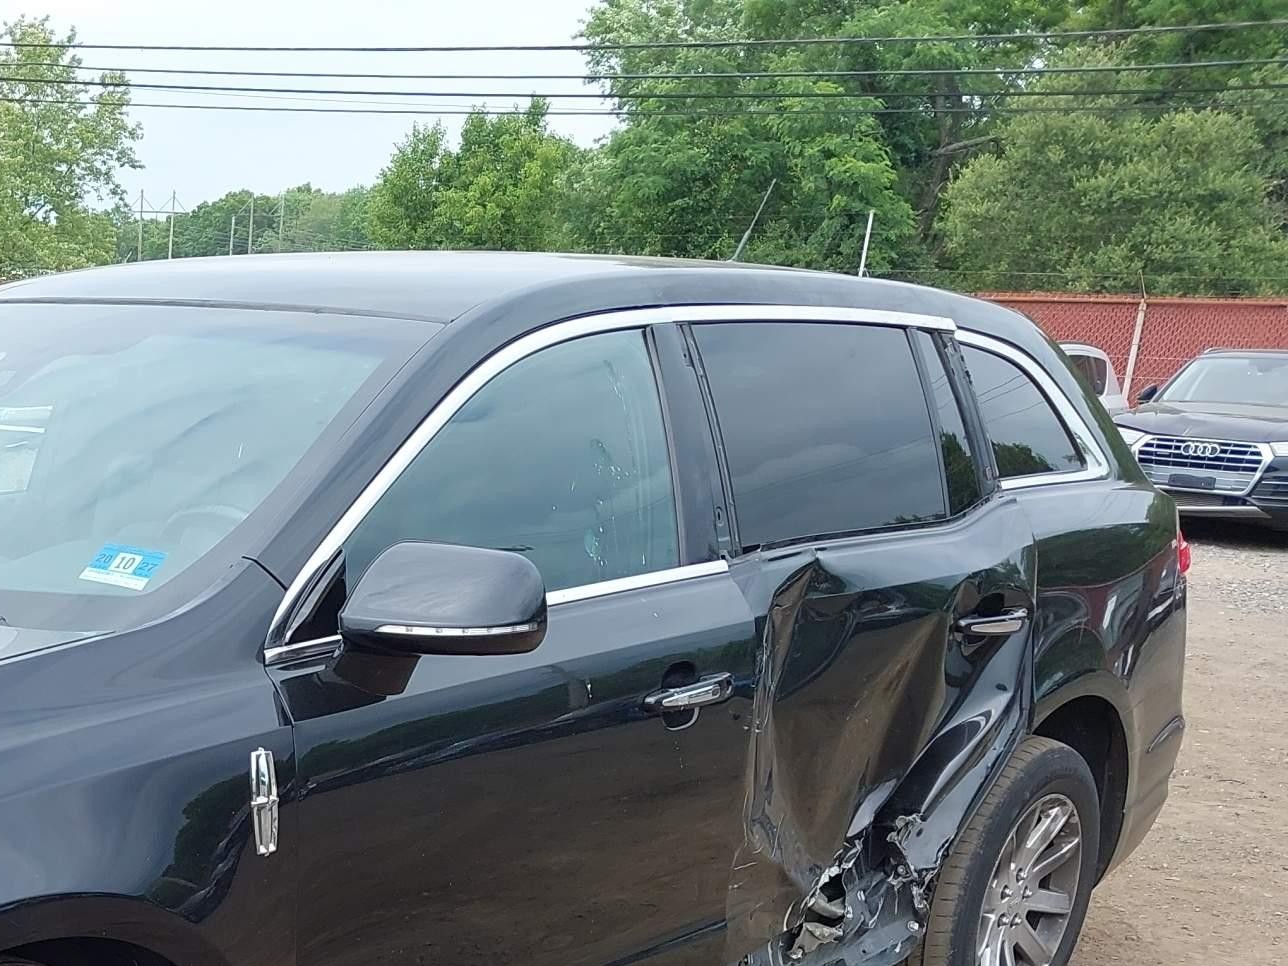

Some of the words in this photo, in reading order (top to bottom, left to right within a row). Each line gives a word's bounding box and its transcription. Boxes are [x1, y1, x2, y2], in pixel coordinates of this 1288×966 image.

[95, 552, 113, 564] 20
[114, 555, 137, 570] 10
[138, 561, 160, 572] 27
